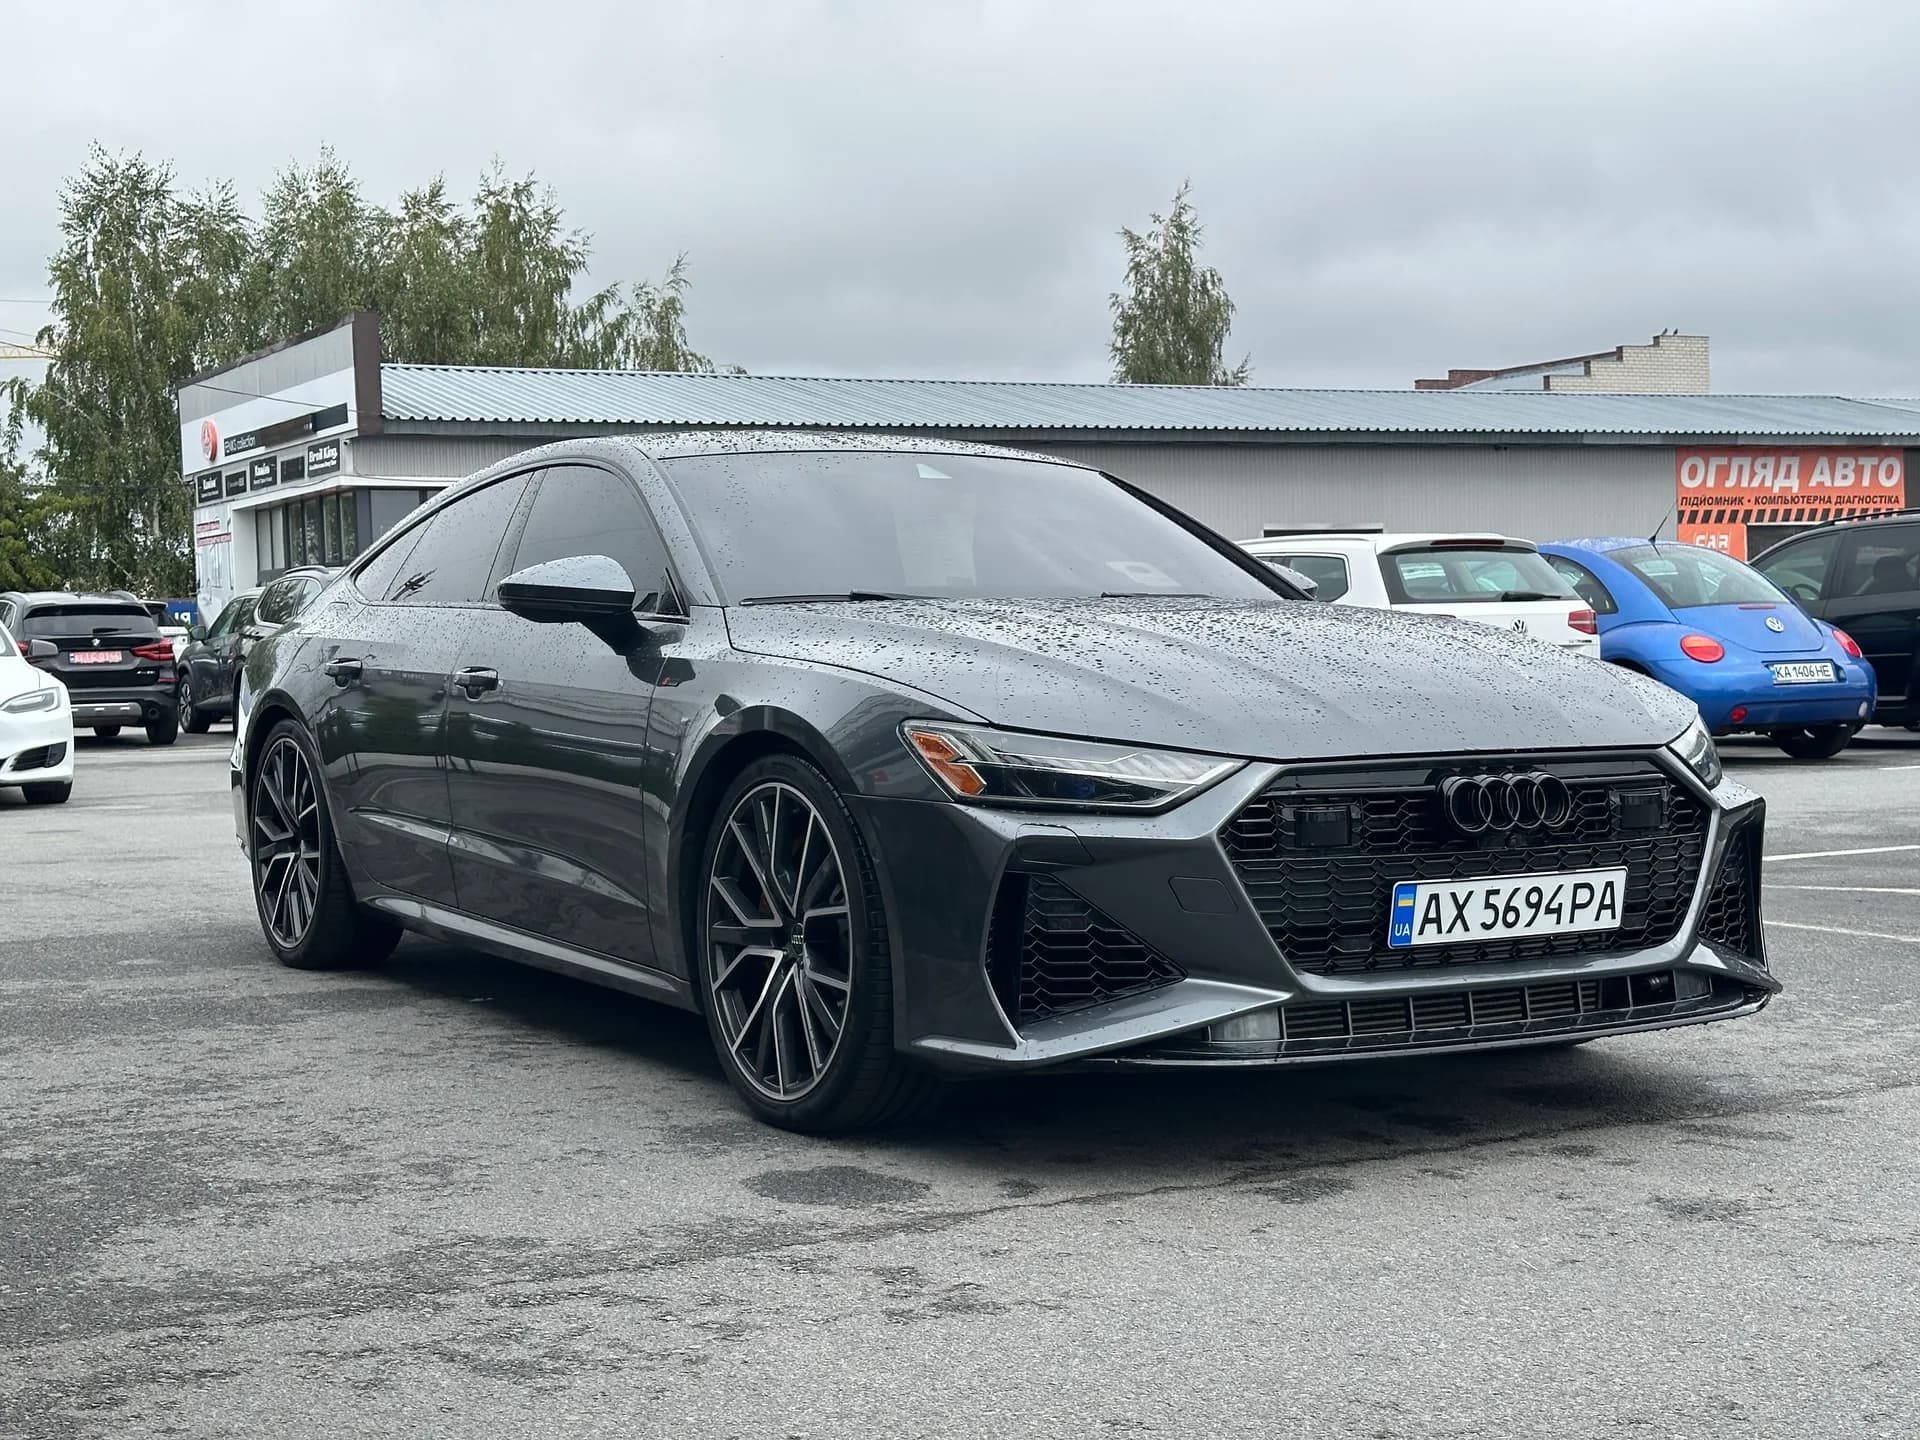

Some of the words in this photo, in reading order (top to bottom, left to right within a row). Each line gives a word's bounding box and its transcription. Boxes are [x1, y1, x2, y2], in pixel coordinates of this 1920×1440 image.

[1681, 456, 1799, 493] ОГЛЯД
[1808, 456, 1900, 487] АВТО
[1681, 495, 1744, 507] ПІДЙОМНИК
[1754, 495, 1832, 505] КОМПЬЮТЕРНА
[1835, 495, 1900, 506] ДІАГНОСТІКА
[1695, 534, 1729, 549] CAR
[1395, 923, 1410, 936] UA
